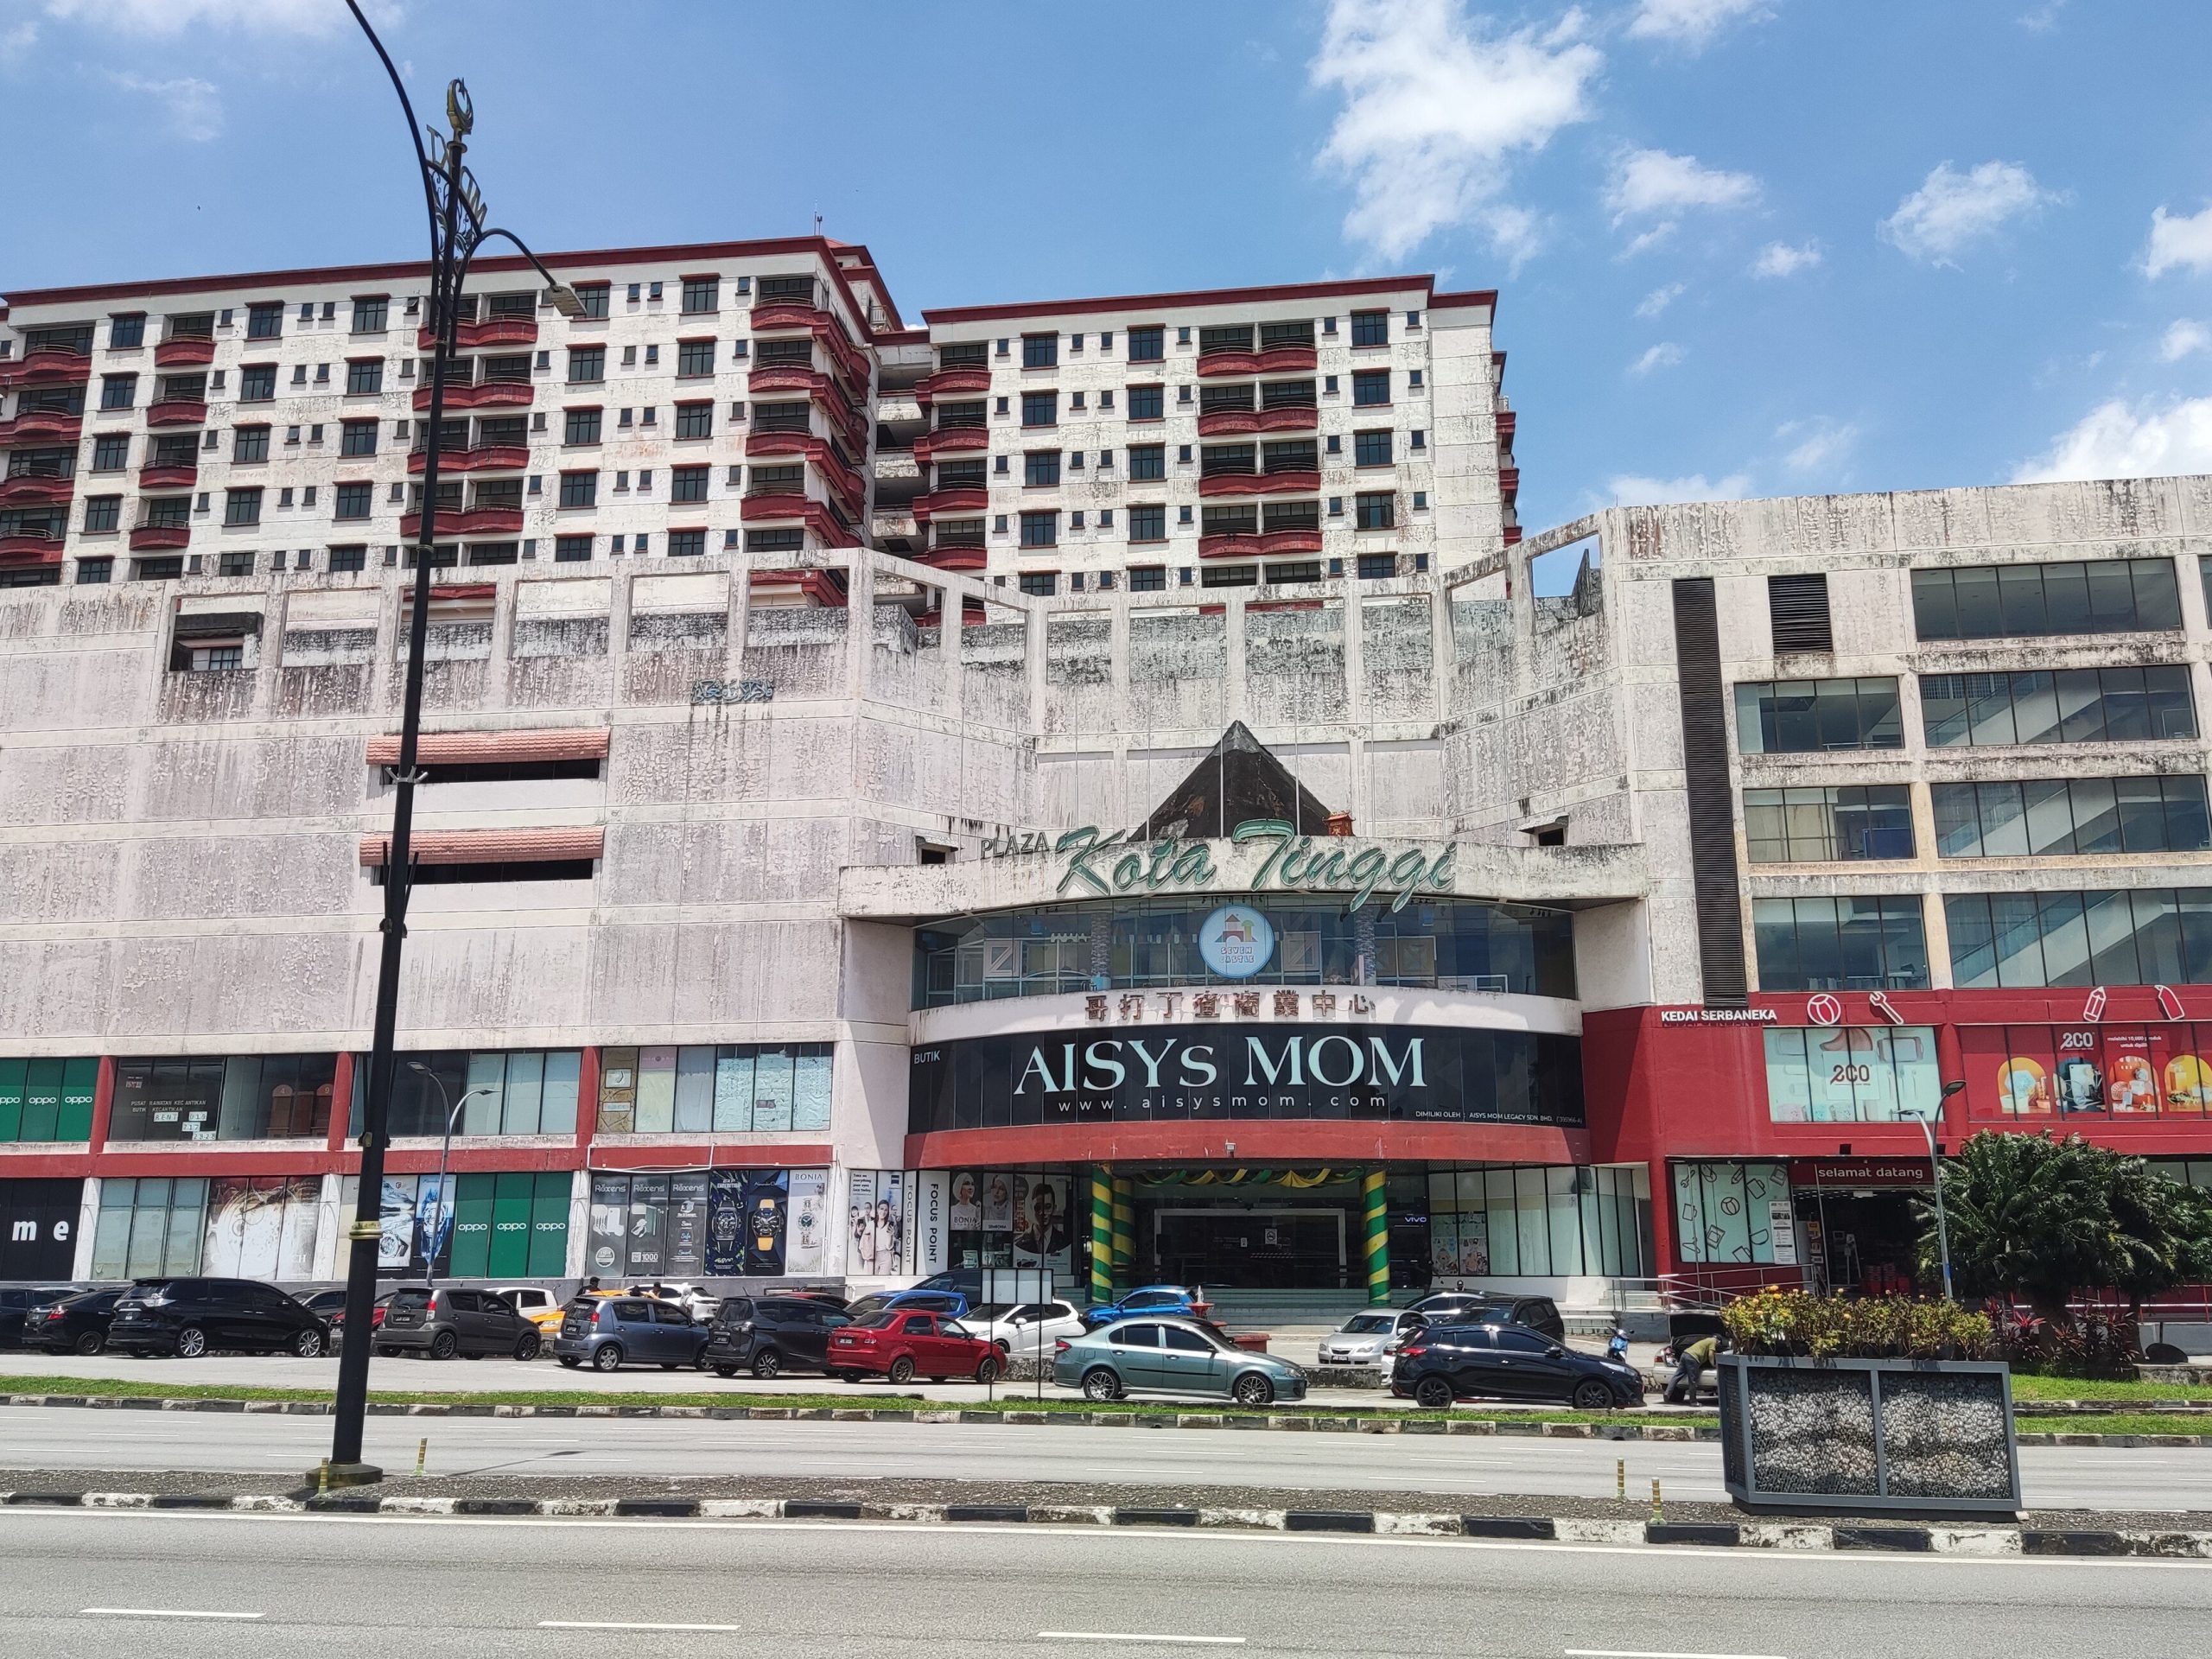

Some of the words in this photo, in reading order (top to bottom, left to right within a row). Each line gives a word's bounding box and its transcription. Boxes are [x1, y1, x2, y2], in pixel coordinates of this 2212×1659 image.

[981, 831, 1051, 859] PLAZA
[1055, 824, 1217, 896] Kota
[1231, 818, 1458, 914] Tinggi
[1220, 946, 1253, 955] SEVEN
[1218, 955, 1255, 963] CASTLE
[1661, 1010, 1698, 1022] KEDAI
[1700, 1009, 1777, 1021] SERBANEKA
[913, 1050, 941, 1065] BUTIK
[1243, 1035, 1428, 1088] MOM
[0, 1096, 20, 1105] ppo
[29, 1096, 56, 1105] oppo
[65, 1096, 92, 1105] oppo
[1818, 1167, 1872, 1178] selamat
[1876, 1167, 1923, 1179] datang
[930, 1183, 939, 1223] FOCUS
[458, 1224, 487, 1232] oppo
[497, 1223, 527, 1231] oppo
[536, 1223, 566, 1231] oppo
[929, 1227, 938, 1263] POINT
